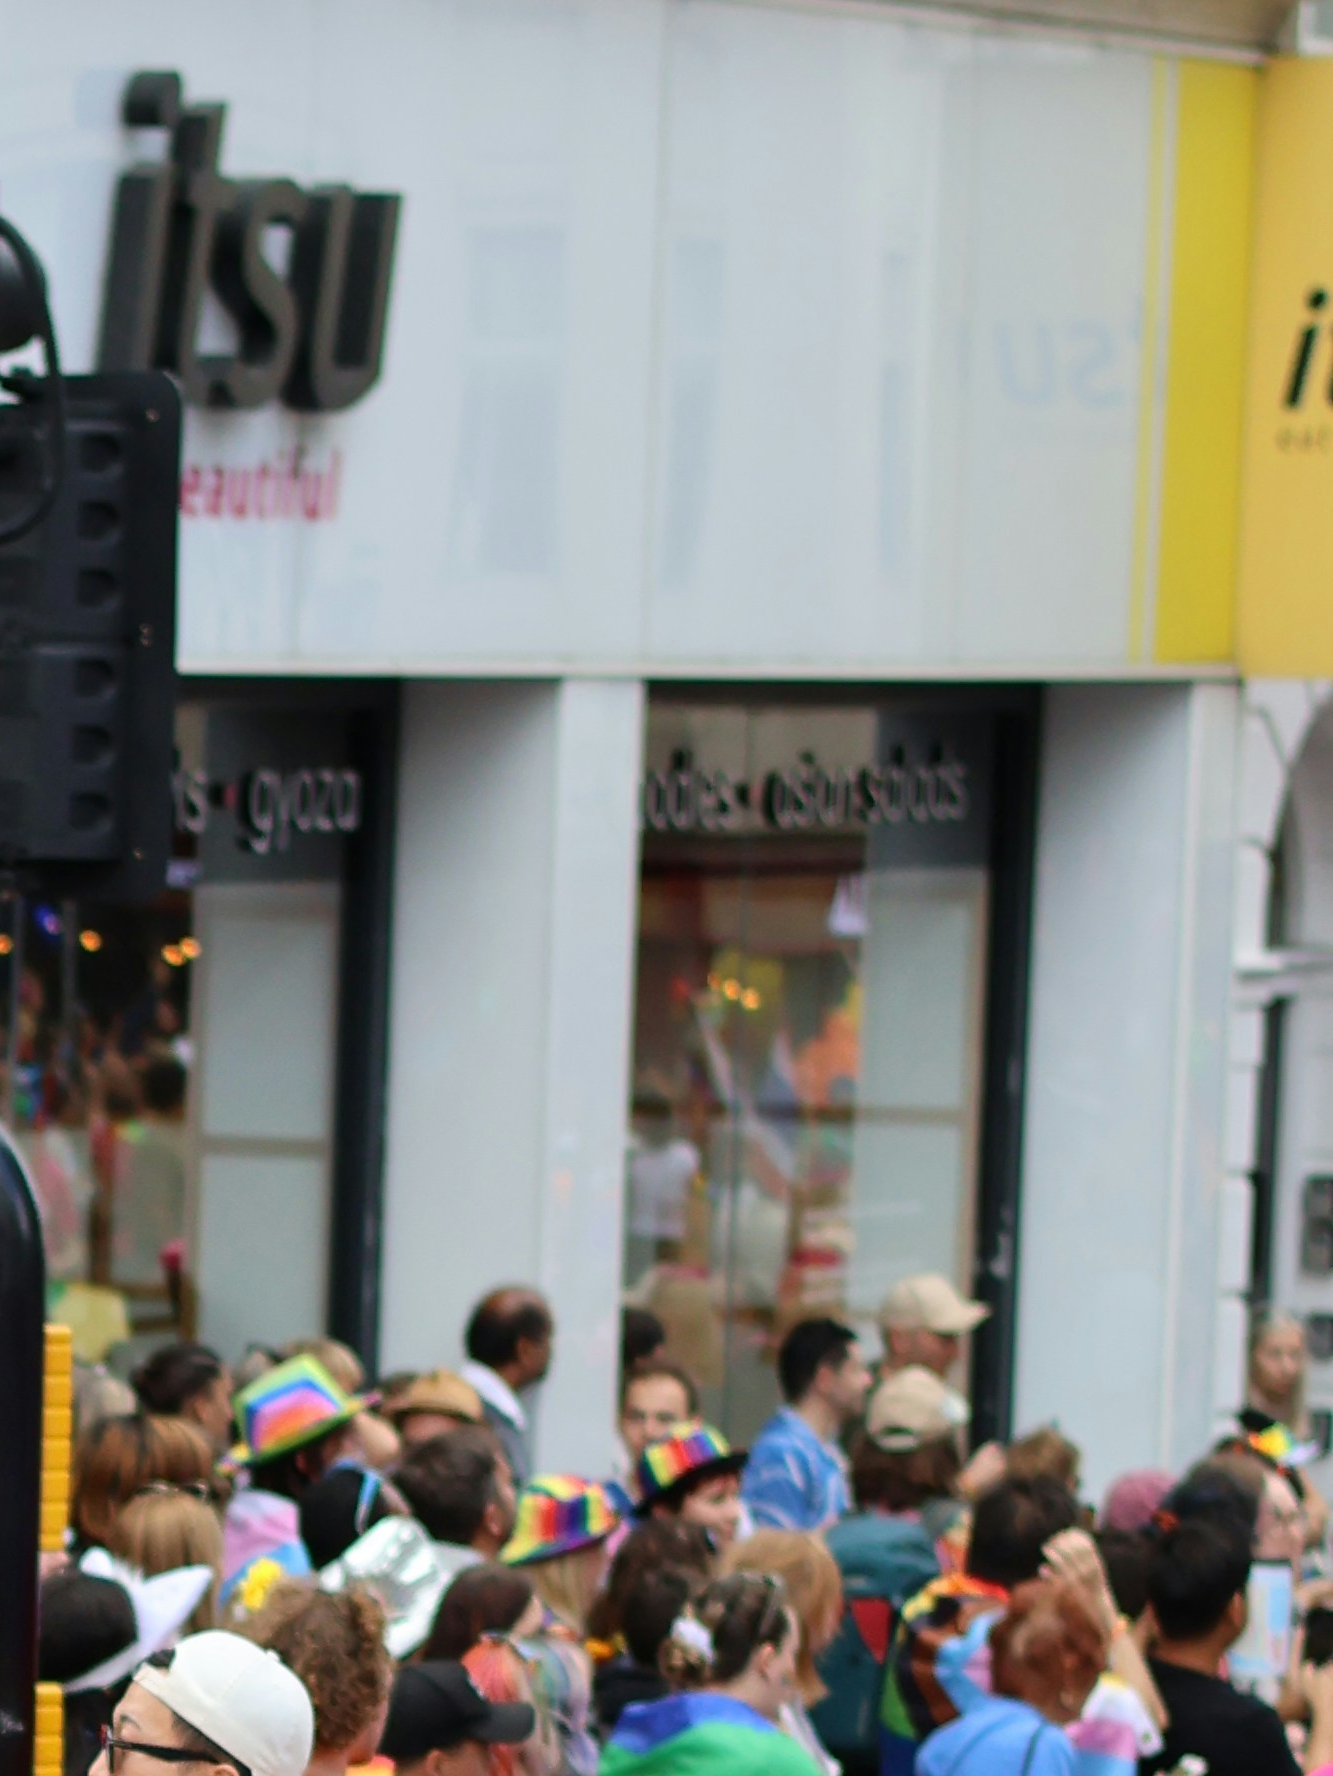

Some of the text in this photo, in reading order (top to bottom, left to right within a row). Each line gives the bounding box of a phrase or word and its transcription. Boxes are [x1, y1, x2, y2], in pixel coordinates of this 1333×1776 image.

[95, 70, 402, 412] itsu
[180, 444, 341, 521] eautiful
[250, 768, 360, 855] gyoza
